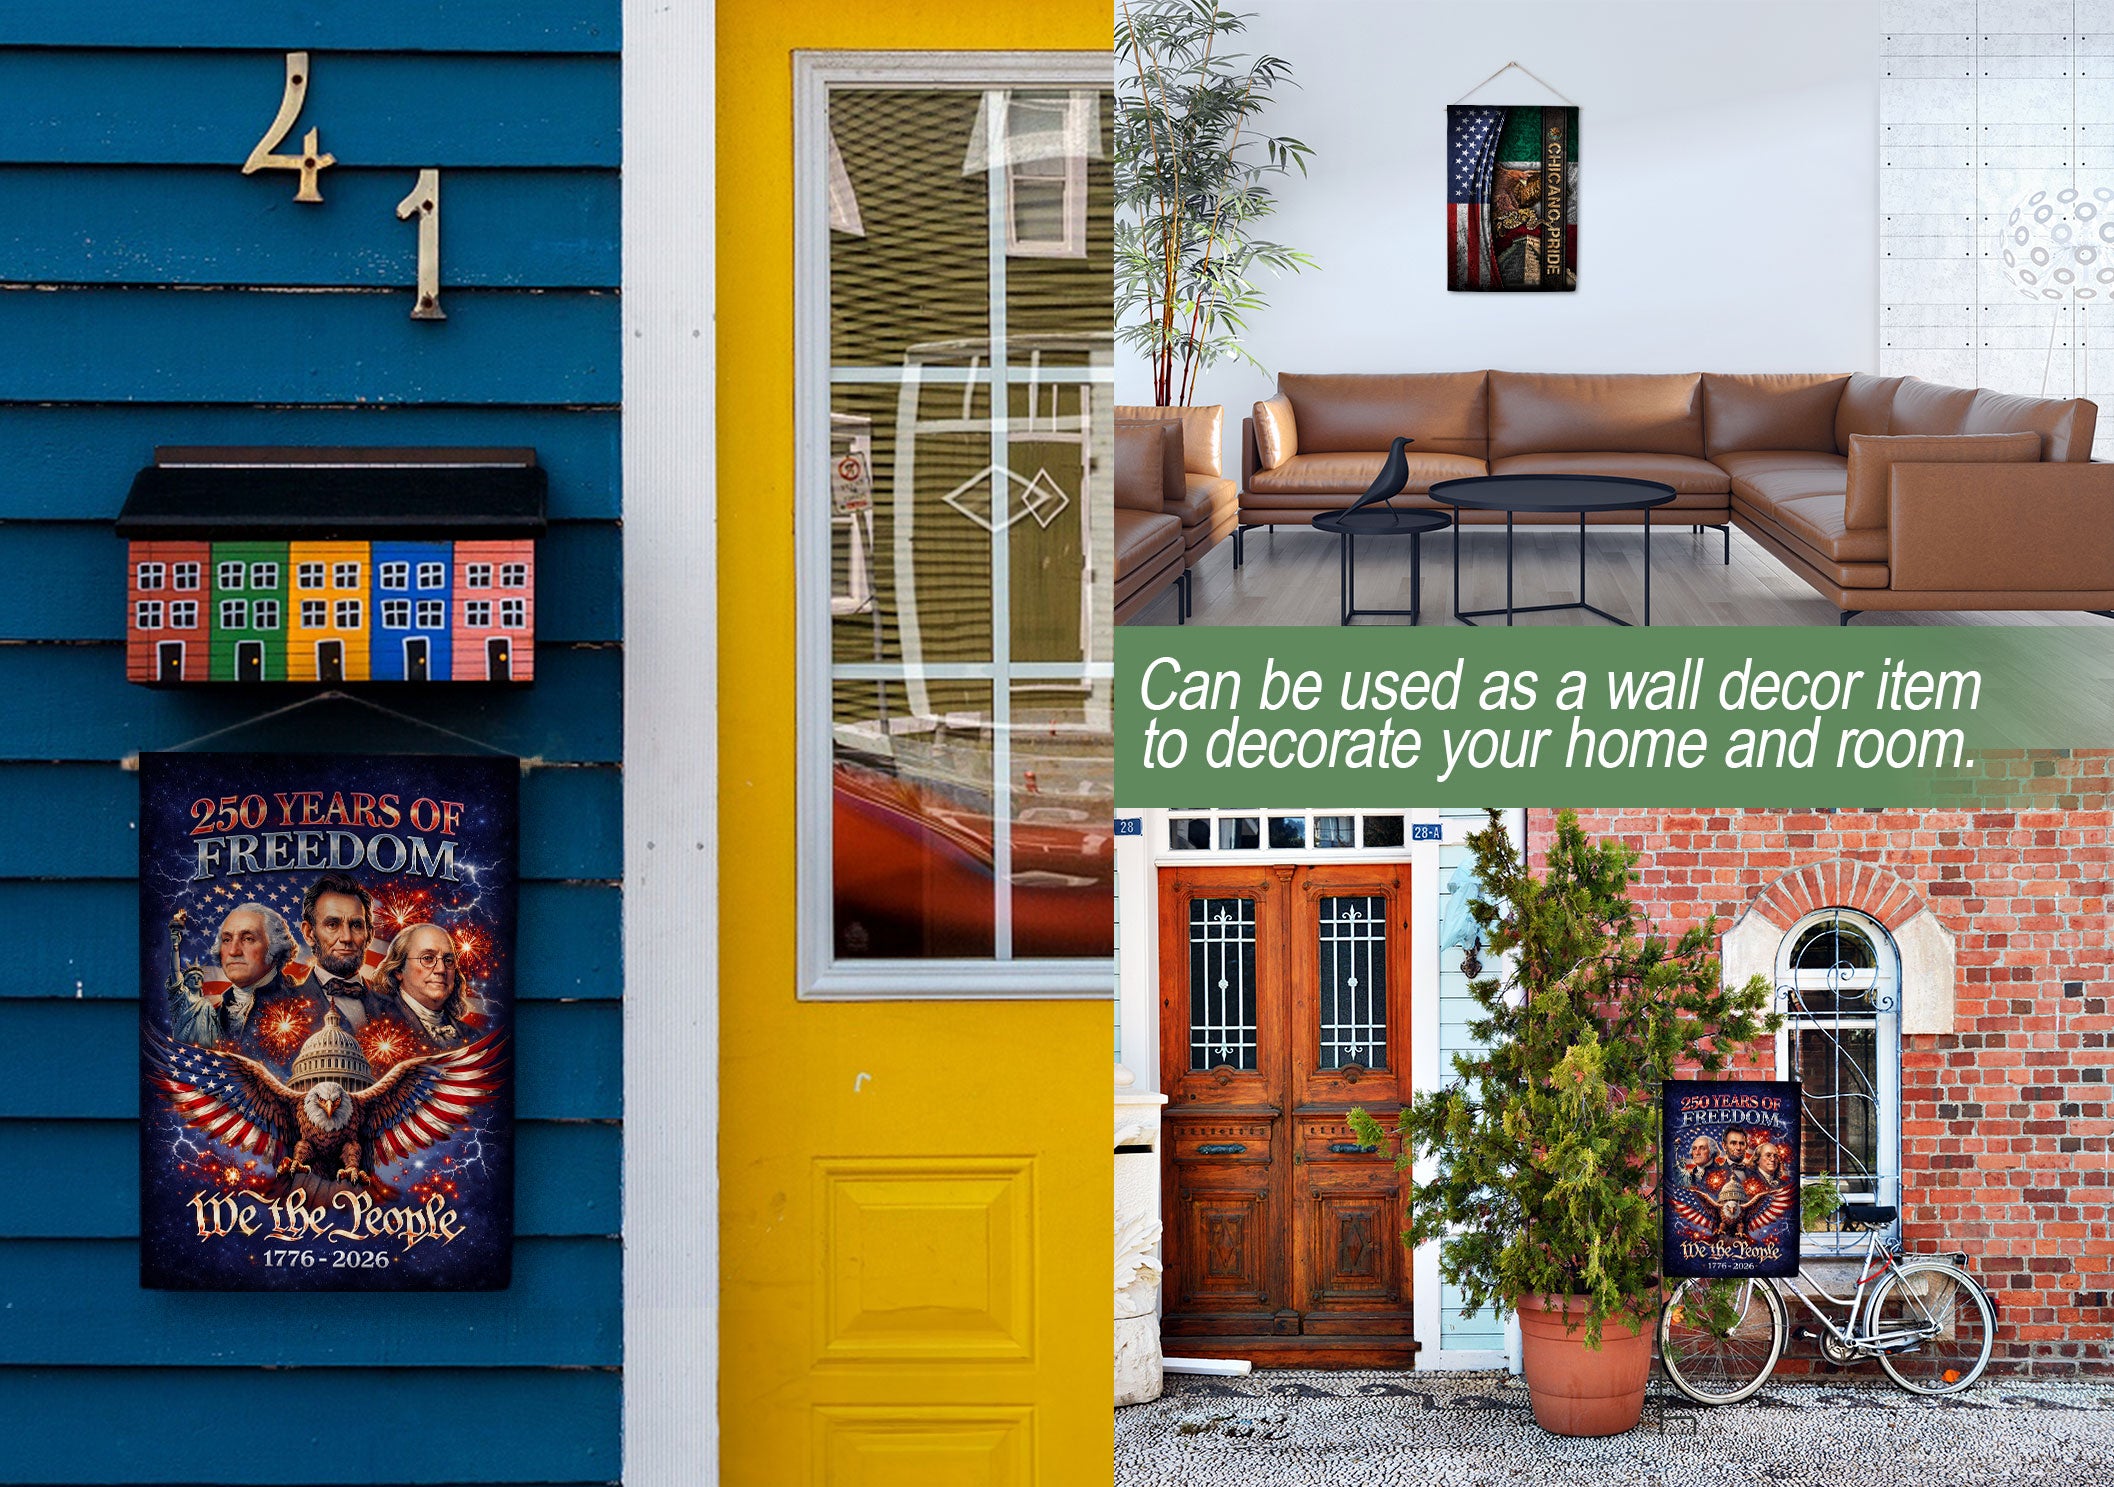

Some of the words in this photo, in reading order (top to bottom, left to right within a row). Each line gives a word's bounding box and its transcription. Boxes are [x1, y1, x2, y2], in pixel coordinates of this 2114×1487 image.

[1547, 144, 1562, 221] CHICANO
[1546, 227, 1561, 275] PRIDE
[189, 794, 268, 836] 250
[273, 791, 401, 829] YEARS
[409, 797, 465, 836] OF
[1120, 822, 1134, 833] 28
[1414, 826, 1440, 840] 28-A
[193, 830, 460, 882] FREEDOM
[1680, 1095, 1709, 1112] 250
[1711, 1094, 1759, 1109] YEARS
[1761, 1096, 1782, 1111] OF
[1681, 1108, 1780, 1128] FREEDOM
[186, 1189, 264, 1243] We
[240, 1187, 335, 1243] the
[328, 1189, 466, 1253] People
[1679, 1240, 1707, 1261] We
[1704, 1239, 1735, 1261] the
[1731, 1240, 1783, 1263] People
